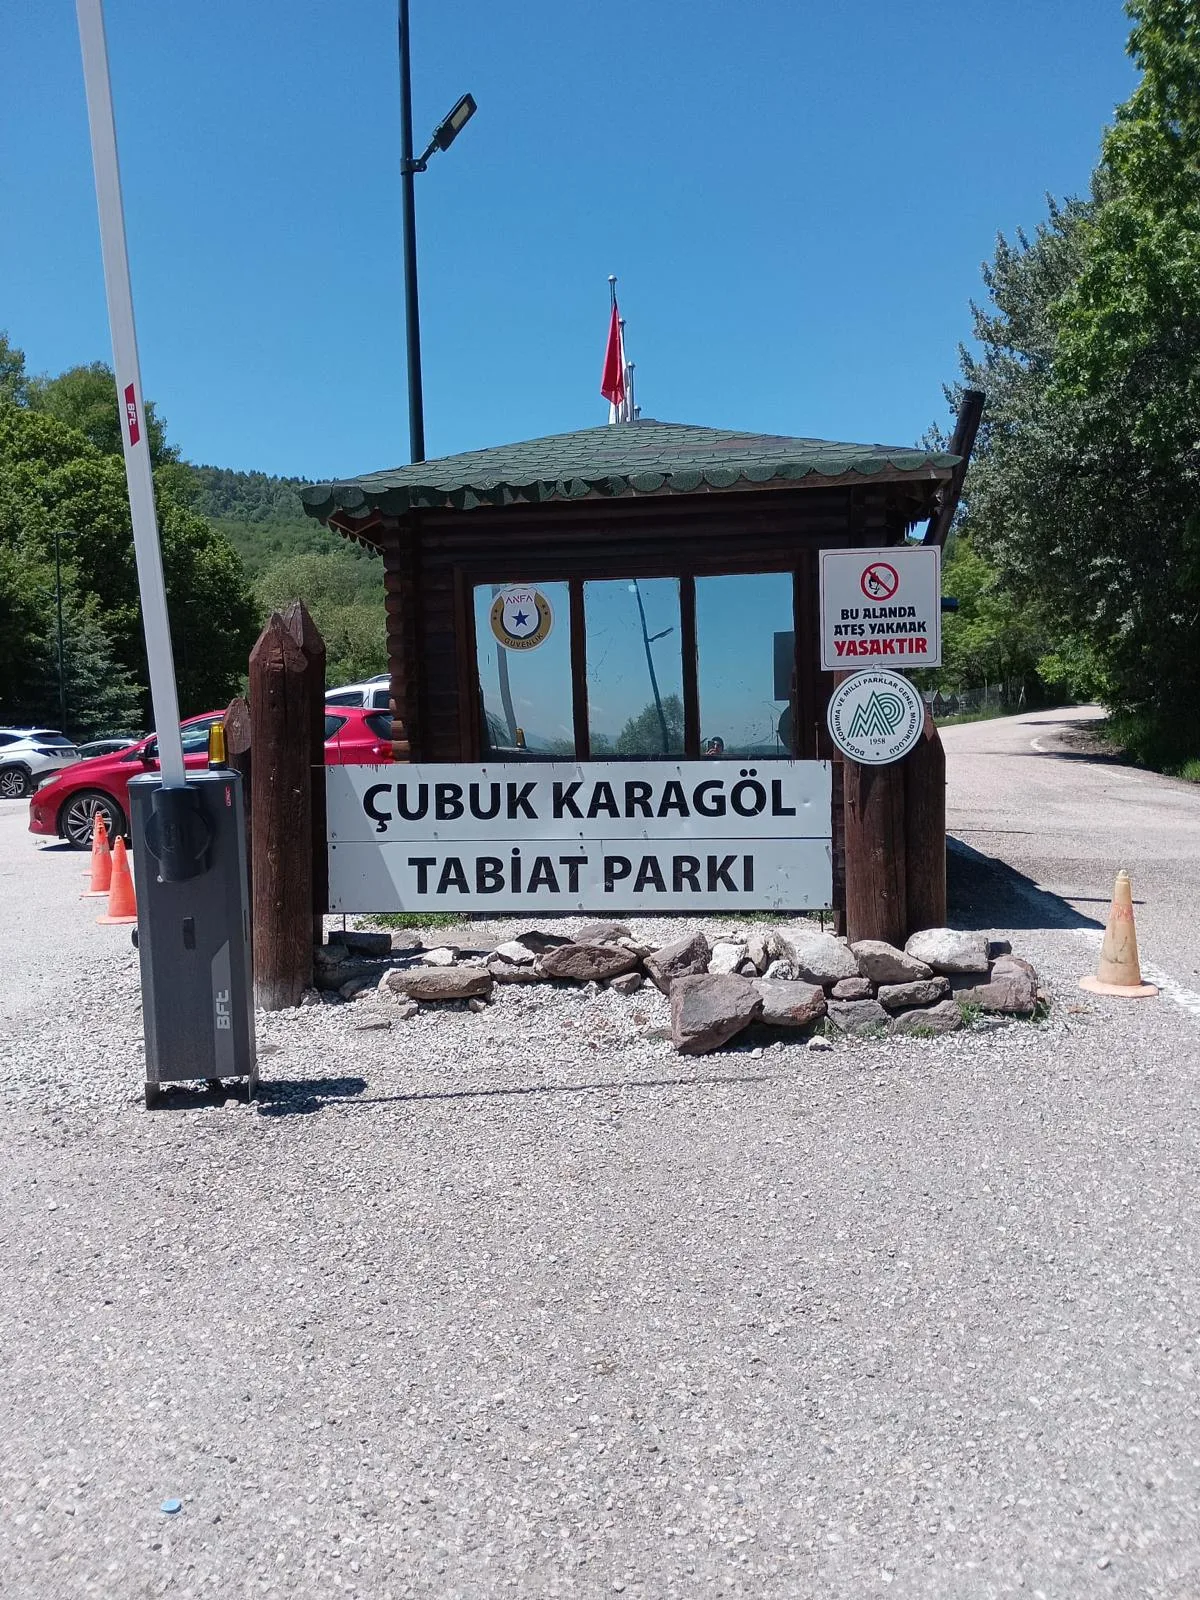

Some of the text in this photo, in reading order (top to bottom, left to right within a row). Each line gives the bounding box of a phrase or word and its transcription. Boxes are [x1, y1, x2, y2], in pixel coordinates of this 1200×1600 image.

[841, 606, 917, 621] BU ALANDA
[833, 621, 927, 637] ATEŞ YAKMAK
[833, 638, 928, 656] YASAKTIR
[863, 677, 899, 689] PARKLAR
[837, 697, 845, 707] VE
[898, 687, 914, 711] GENEL
[834, 709, 847, 742] KORUMA
[869, 738, 886, 746] 1958
[363, 768, 797, 833] ÇUBUK KARAGÖL
[407, 847, 754, 895] TABİAT PARKI
